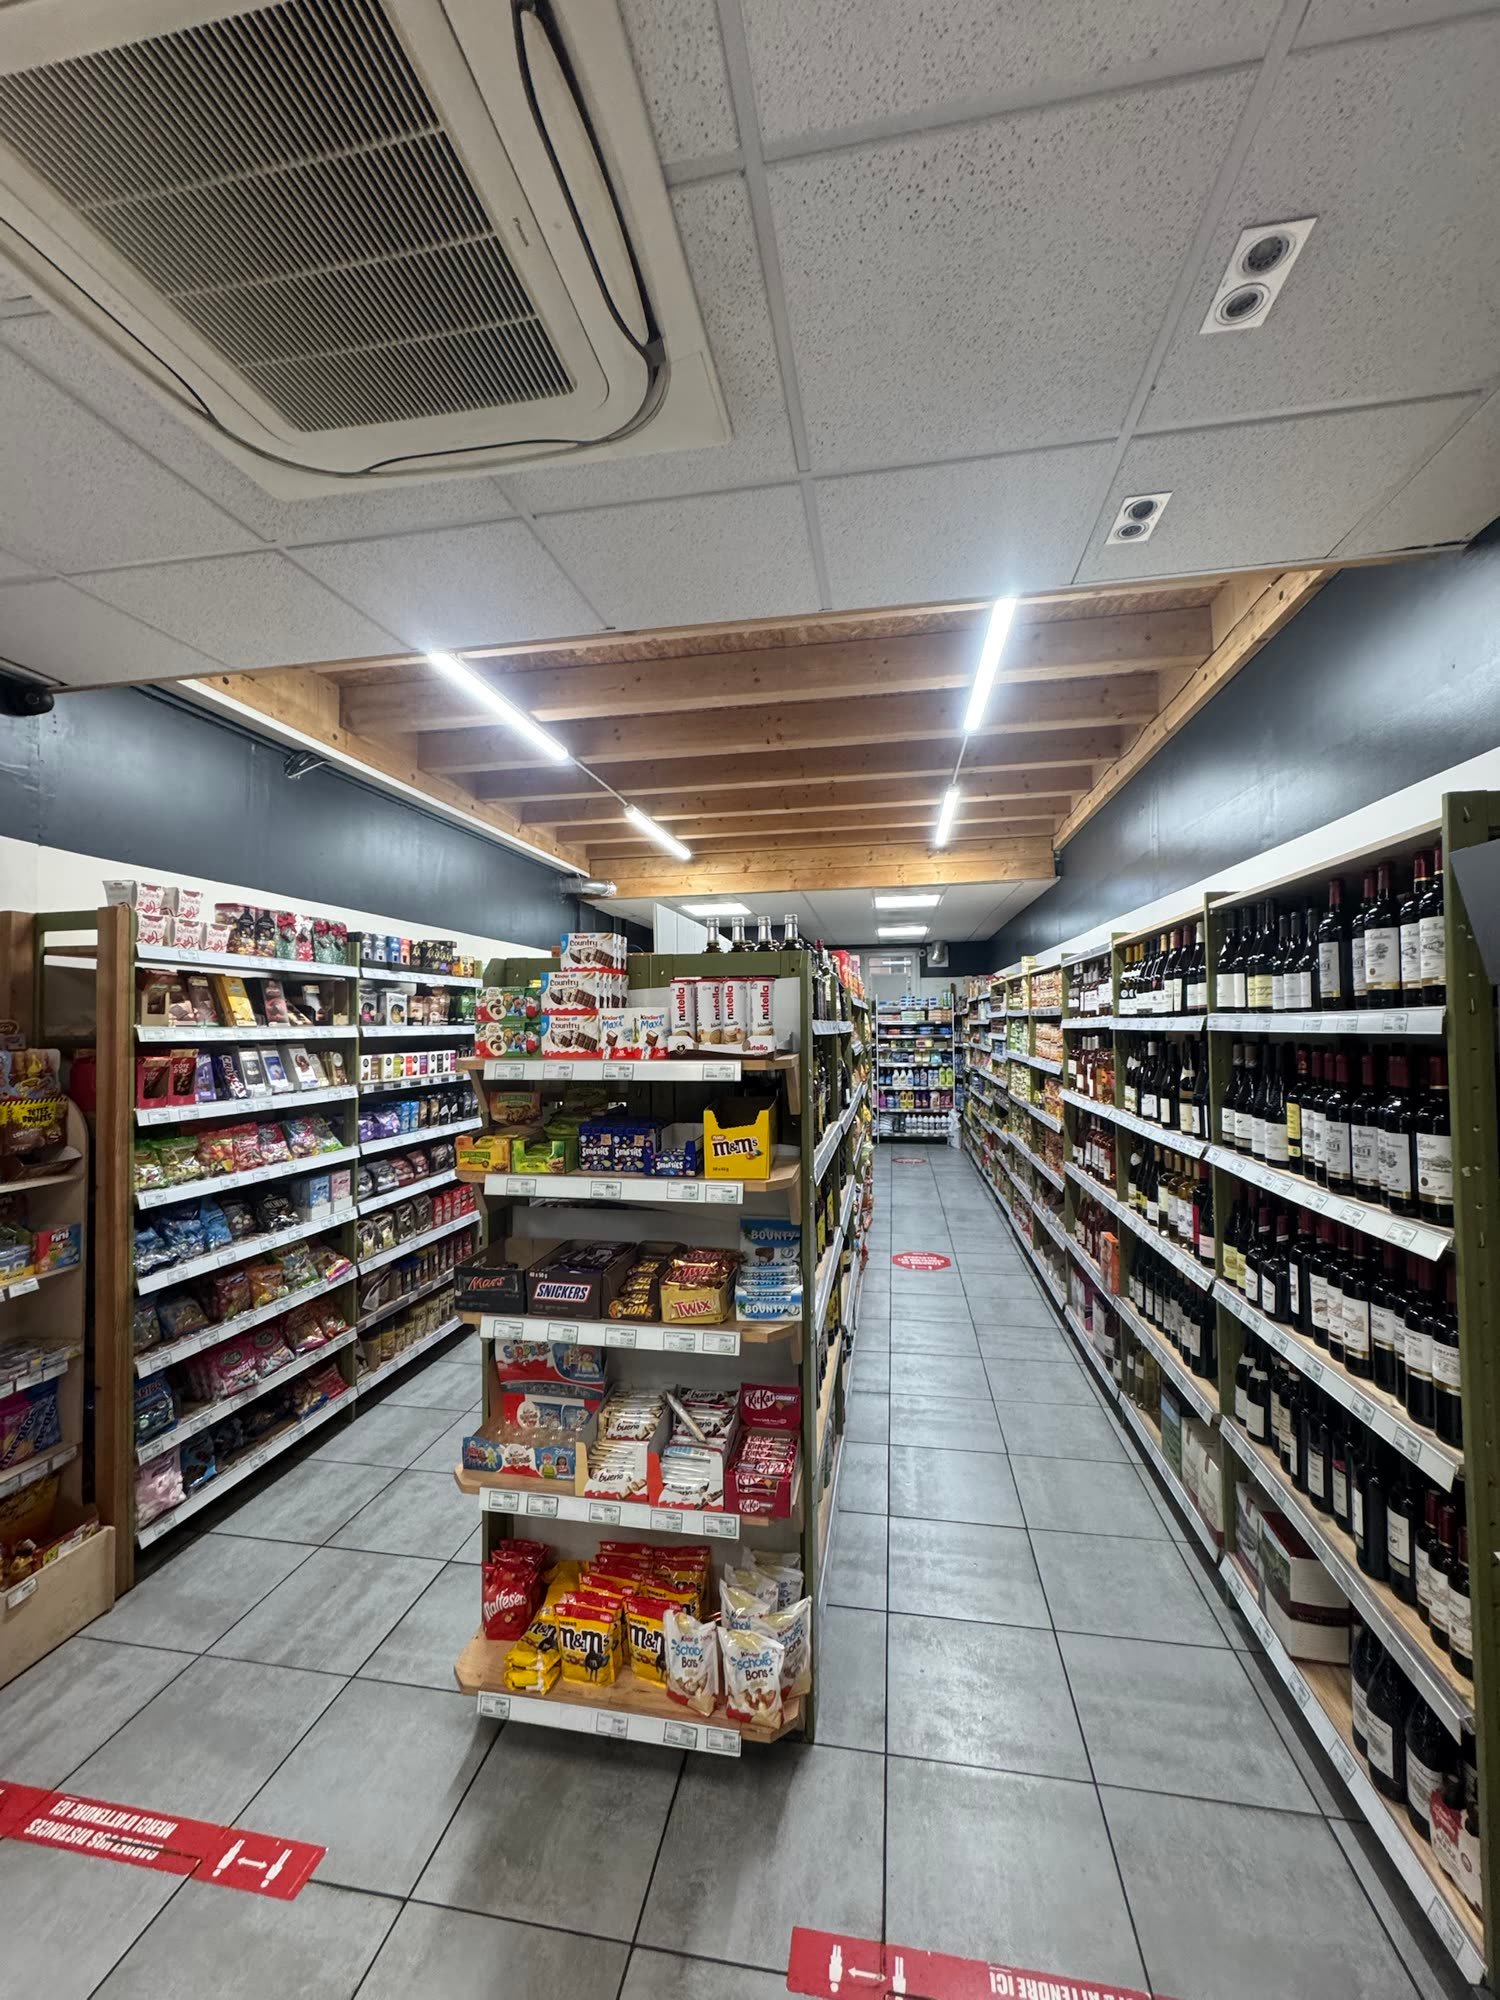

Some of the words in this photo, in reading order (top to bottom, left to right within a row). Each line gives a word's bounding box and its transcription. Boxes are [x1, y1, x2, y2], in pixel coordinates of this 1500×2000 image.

[569, 939, 598, 948] Country
[550, 979, 579, 988] Country
[676, 987, 686, 1022] nutella
[712, 985, 721, 1021] nutella
[725, 985, 734, 1020] nutella
[760, 985, 770, 1020] nutella
[550, 1022, 579, 1031] Country
[751, 1230, 795, 1240] BOUNTY
[537, 1284, 589, 1300] SNICKERS
[745, 1304, 785, 1314] BOUNTY
[616, 1423, 640, 1432] bueno
[598, 1472, 624, 1482] bueno
[745, 1669, 769, 1681] Bons
[48, 1799, 76, 1818] ICI
[23, 1817, 95, 1846] DISTANCES
[131, 1815, 179, 1839] MERCI
[989, 1971, 1015, 1997] ICI
